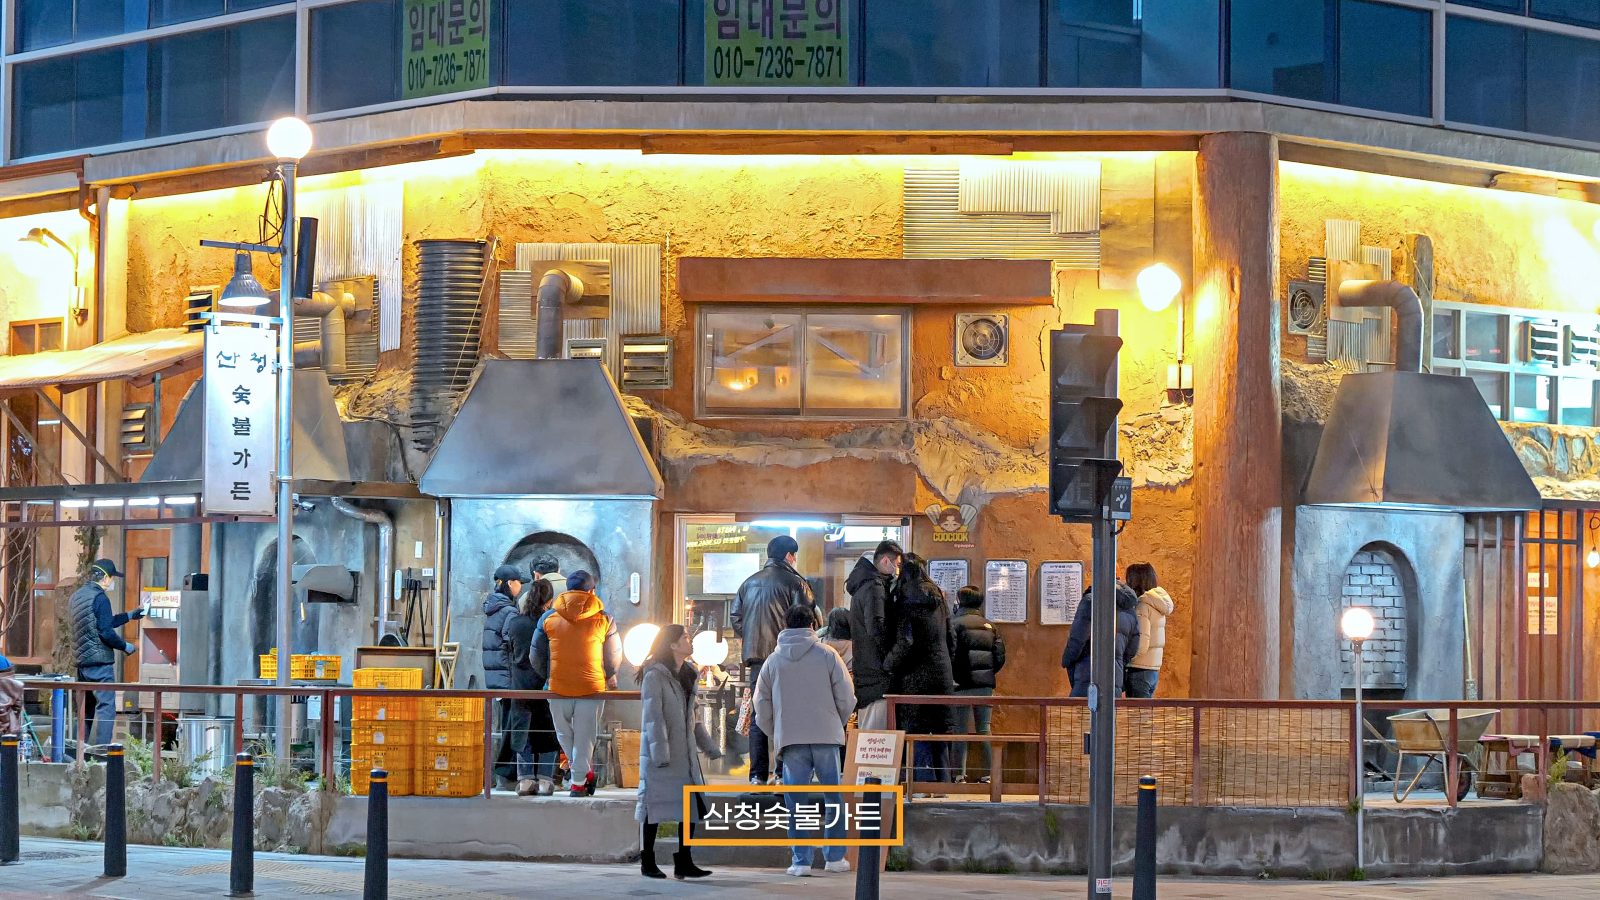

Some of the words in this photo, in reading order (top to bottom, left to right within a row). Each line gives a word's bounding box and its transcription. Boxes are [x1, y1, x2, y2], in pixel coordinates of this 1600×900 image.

[409, 0, 486, 51] 임대문의
[713, 0, 842, 40] 임대문의
[408, 48, 486, 91] 010-7236-7871
[713, 45, 843, 78] 010-7236-7871
[216, 350, 267, 373] 산청
[230, 384, 252, 501] 숯불가든
